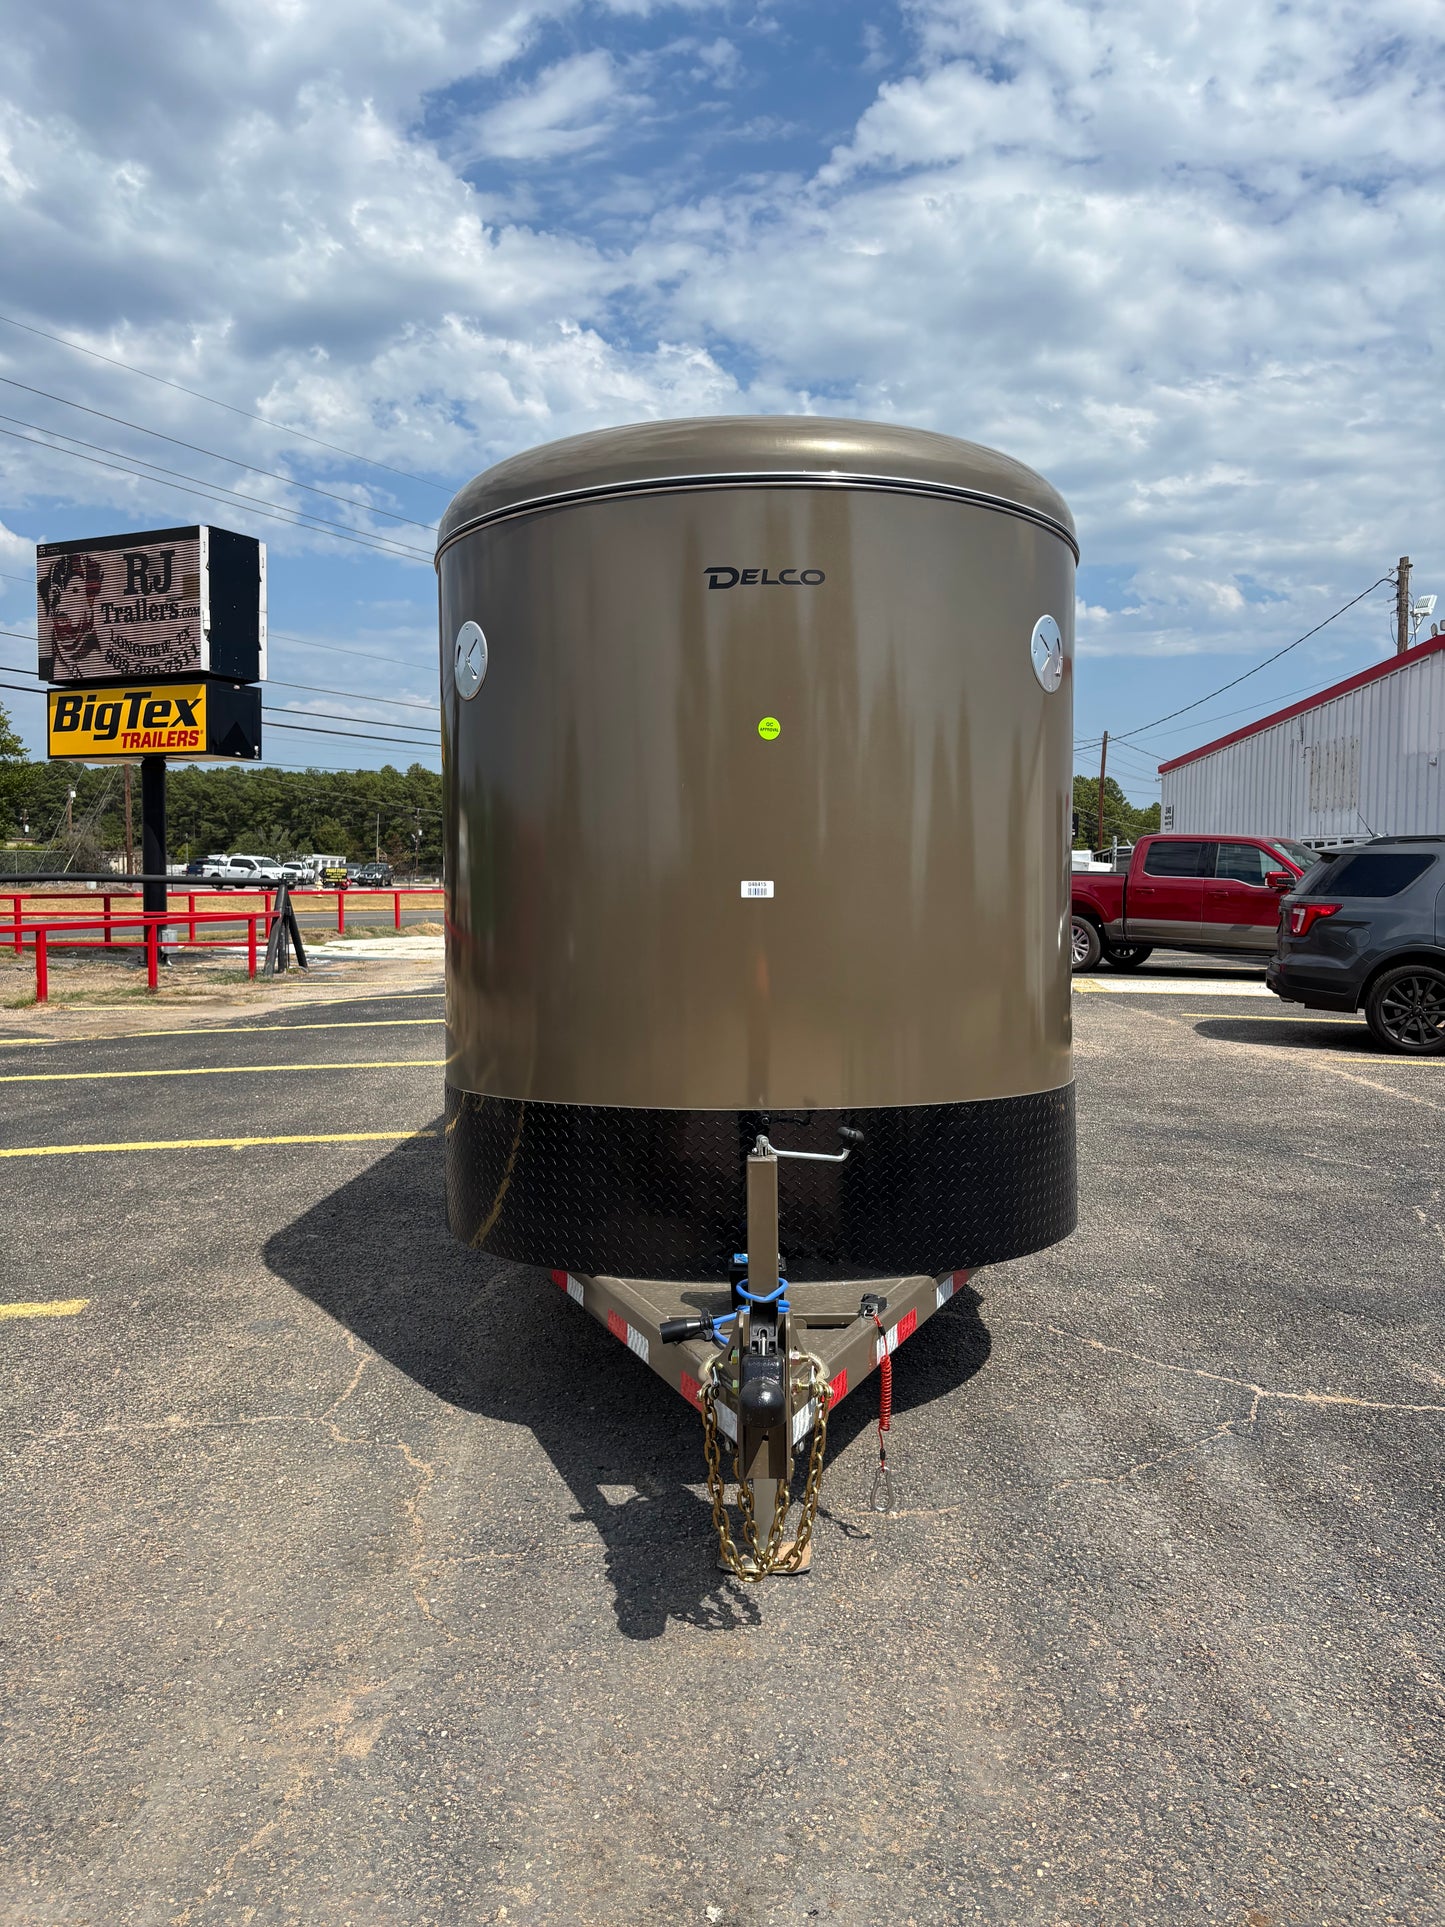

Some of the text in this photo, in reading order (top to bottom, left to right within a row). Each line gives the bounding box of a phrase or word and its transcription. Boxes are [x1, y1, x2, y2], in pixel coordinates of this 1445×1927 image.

[123, 549, 176, 595] RJ
[704, 567, 826, 590] DELCO
[121, 730, 200, 748] TRAILERS
